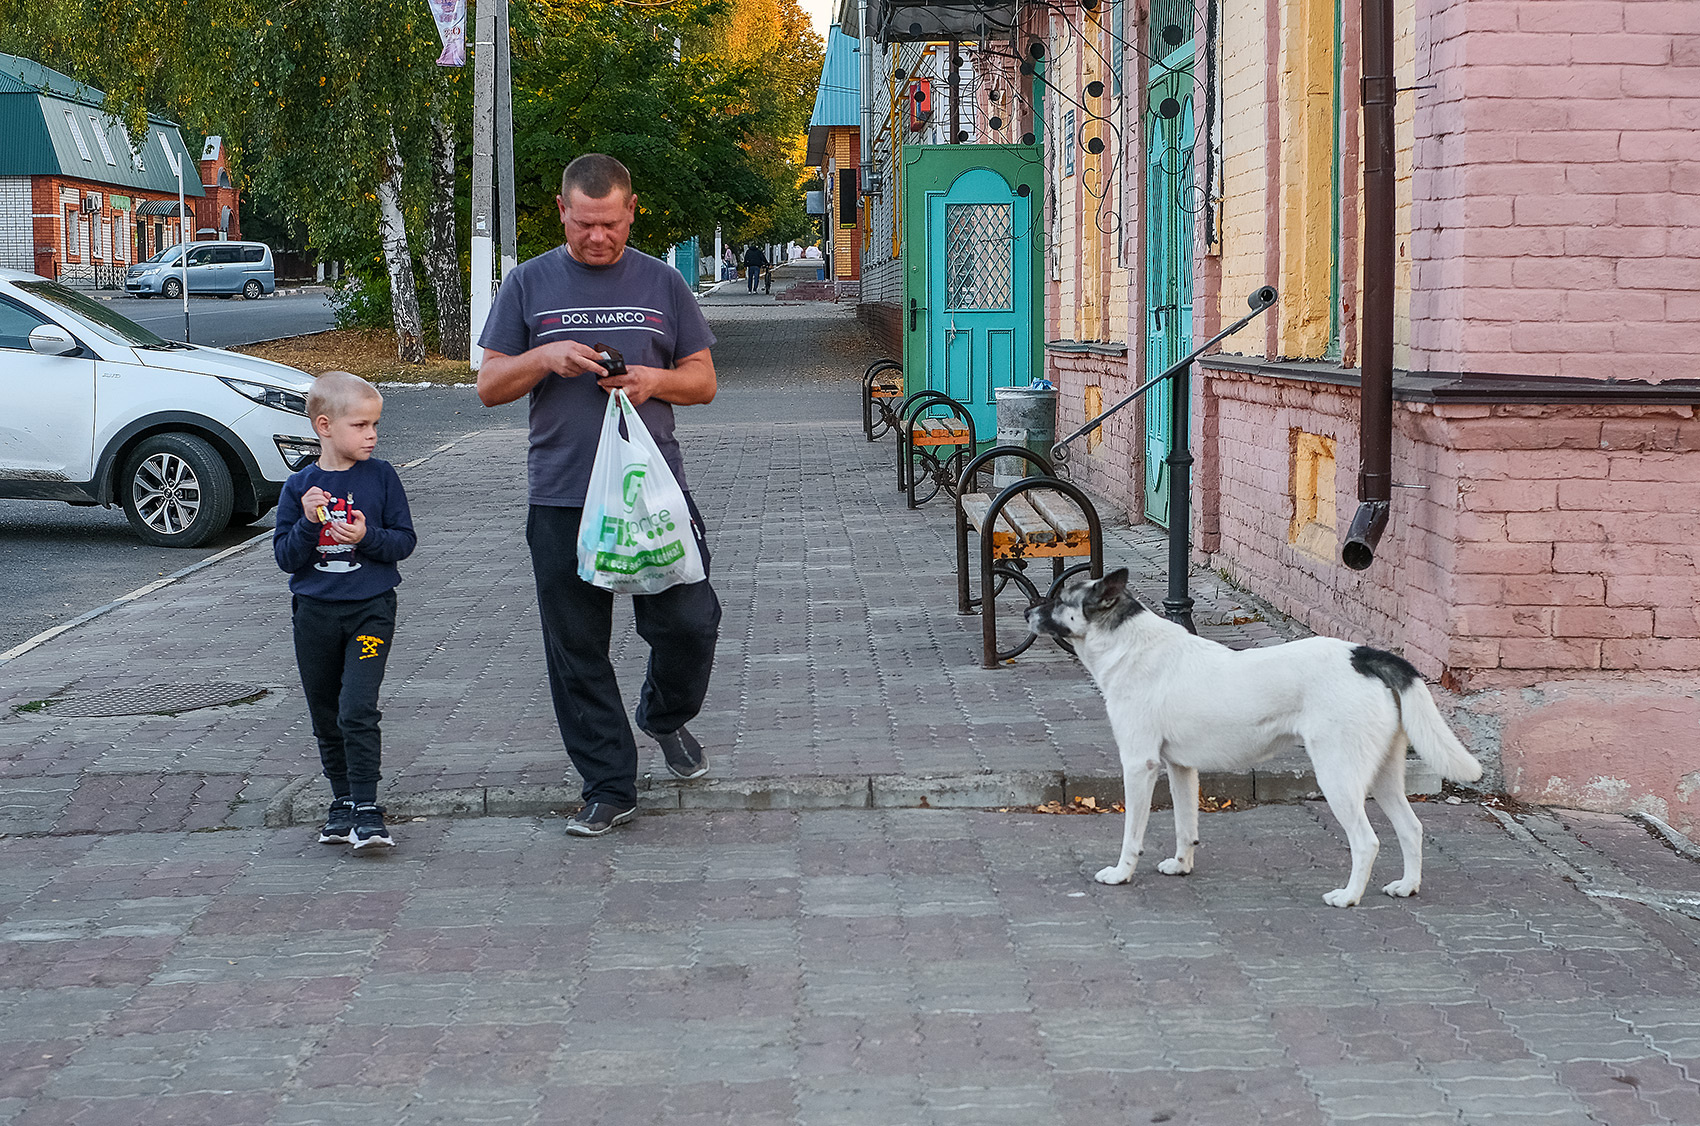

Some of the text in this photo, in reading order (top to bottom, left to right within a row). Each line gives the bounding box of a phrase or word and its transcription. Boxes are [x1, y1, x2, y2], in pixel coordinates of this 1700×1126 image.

[561, 312, 645, 325] DOS. MARCO
[600, 509, 671, 547] Fix price
